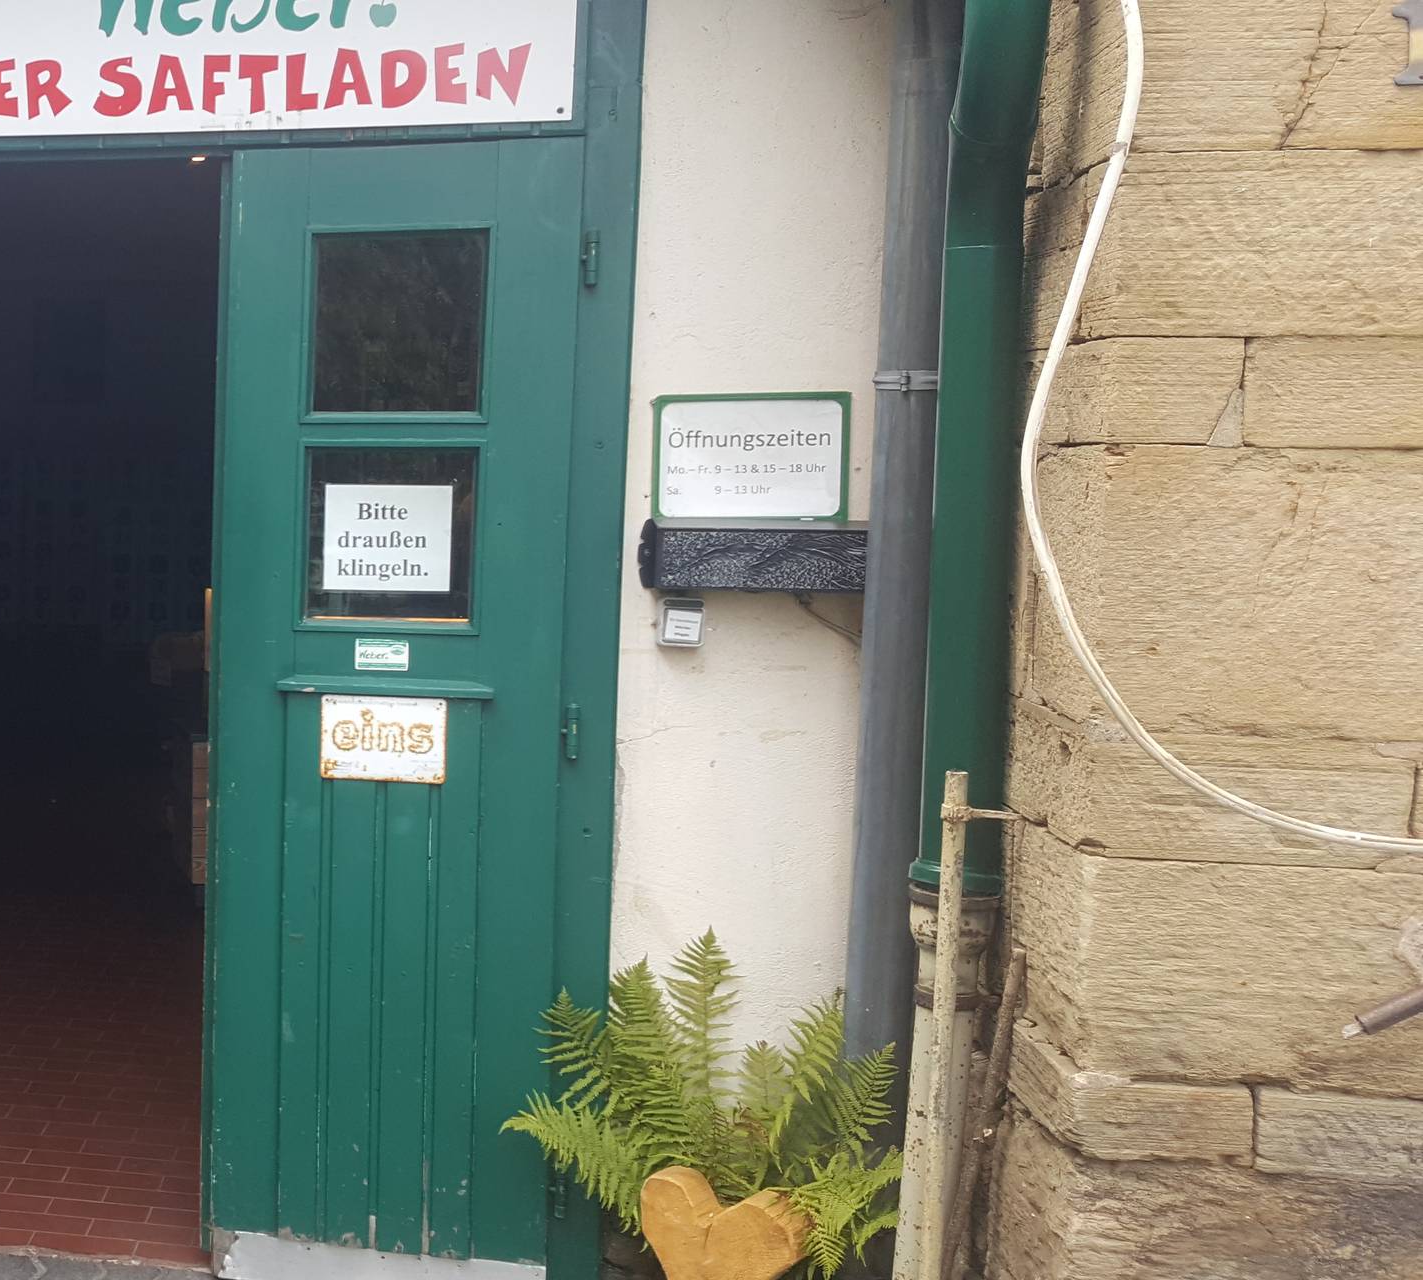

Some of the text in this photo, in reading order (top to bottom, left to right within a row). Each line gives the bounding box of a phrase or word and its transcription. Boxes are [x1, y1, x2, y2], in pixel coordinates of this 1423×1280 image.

[93, 43, 531, 116] SAFTLADEN
[668, 428, 831, 451] Öffnungszeiten
[697, 465, 712, 474] Fr.
[714, 465, 722, 474] 9
[734, 464, 748, 474] 13
[750, 464, 761, 474] &
[763, 464, 777, 473] 15
[789, 463, 803, 473] 18
[805, 463, 827, 473] Uhr
[666, 486, 682, 495] Sa.
[714, 486, 722, 495] 9
[734, 485, 748, 495] 13
[750, 485, 772, 495] Uhr
[357, 502, 409, 520] Bitte
[337, 531, 427, 548] draußen
[337, 559, 429, 580] klingeln.
[332, 708, 434, 754] eins
